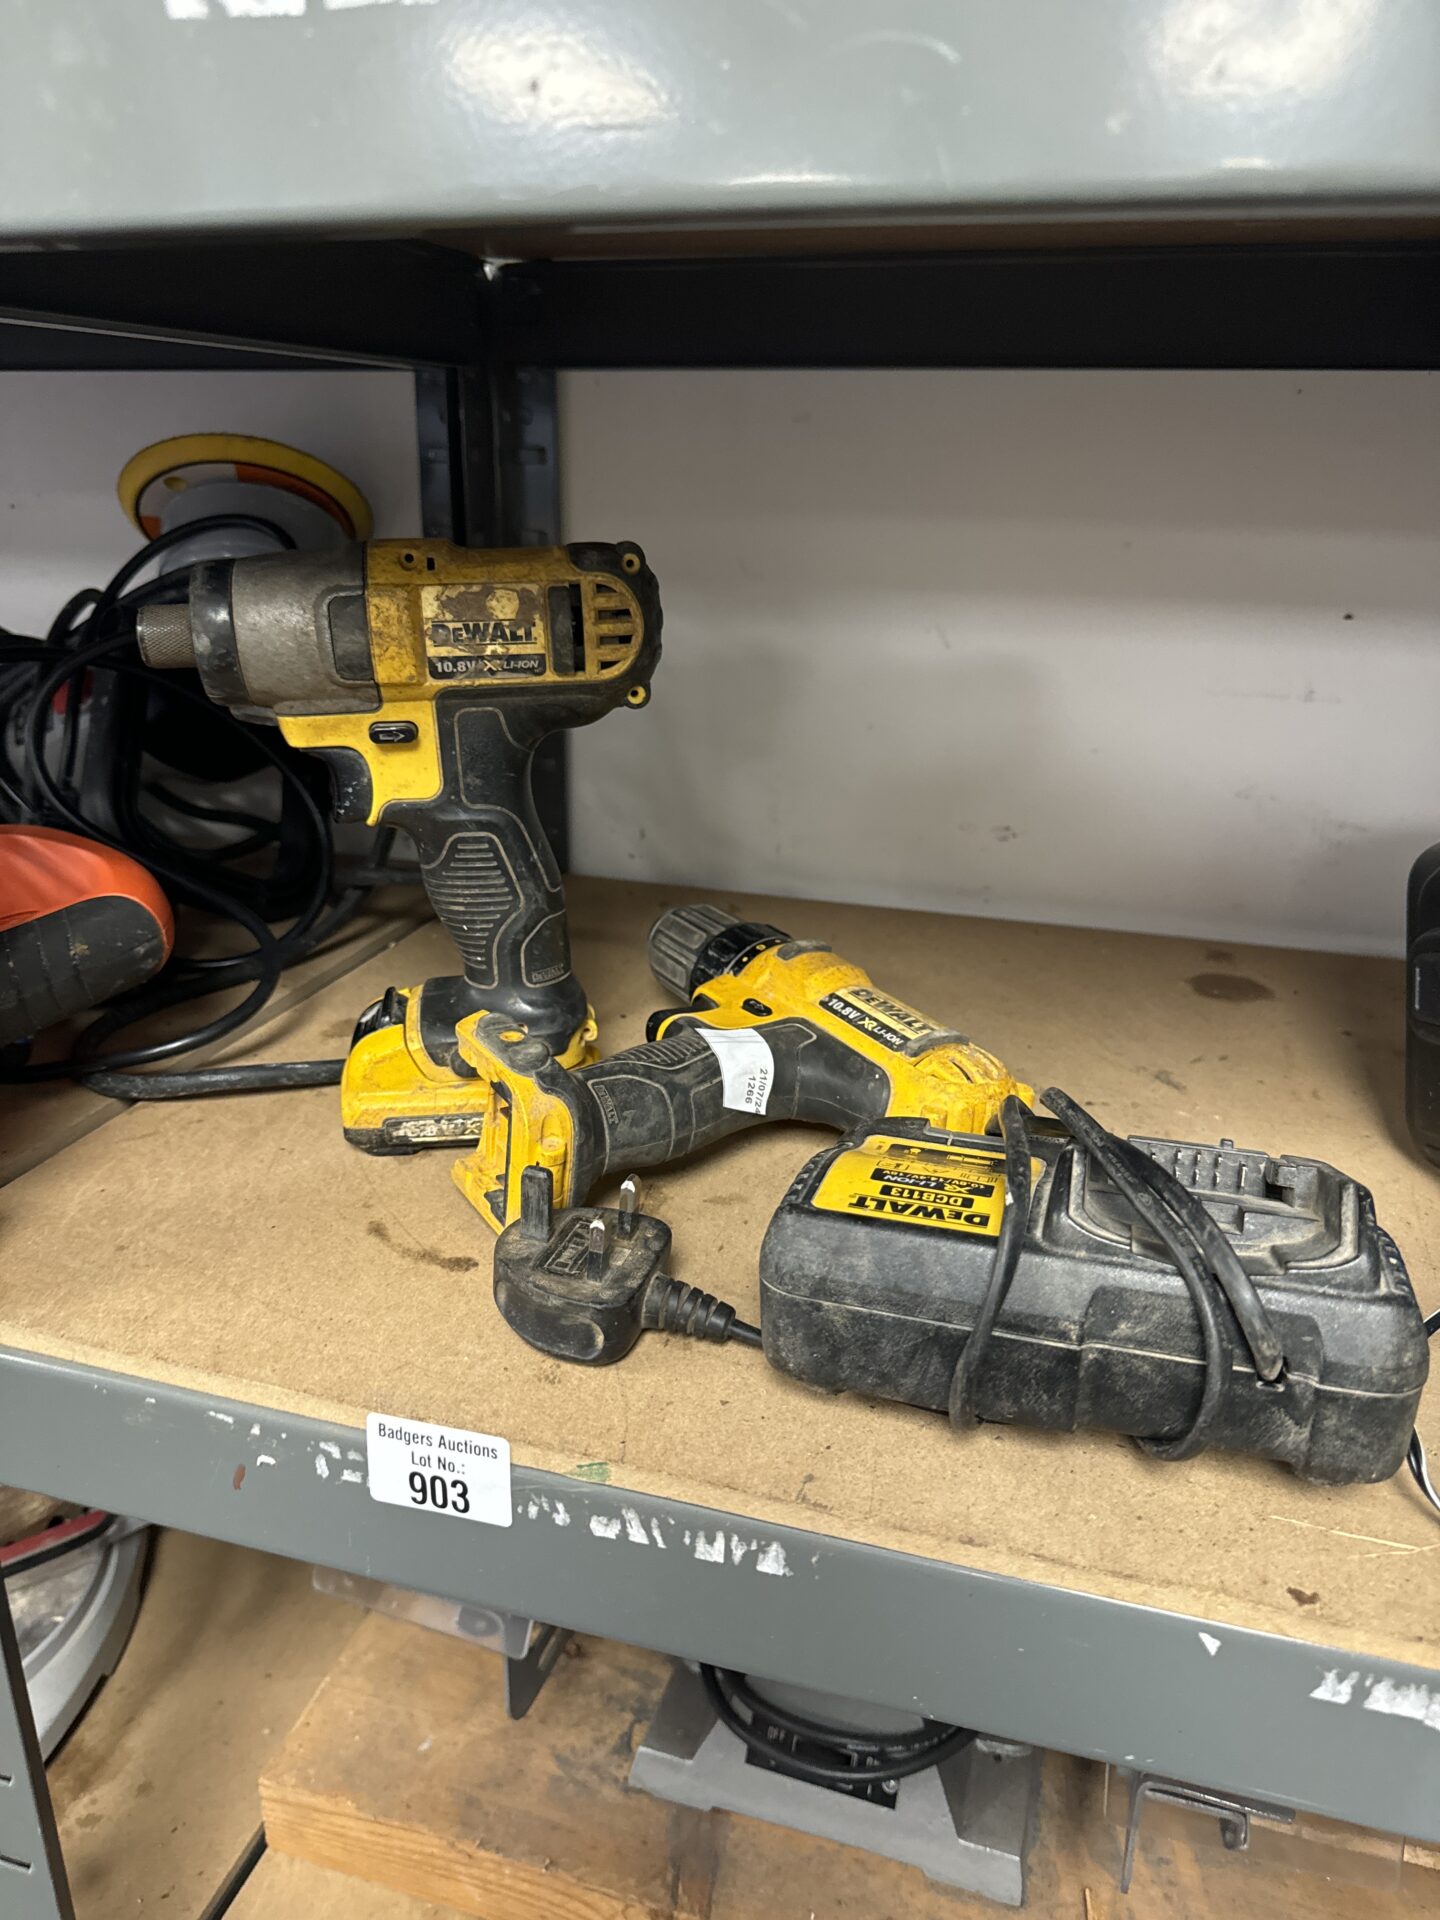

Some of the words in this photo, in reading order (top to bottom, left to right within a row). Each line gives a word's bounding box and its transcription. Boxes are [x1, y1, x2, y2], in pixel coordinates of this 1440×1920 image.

[436, 661, 477, 673] 10.8V
[503, 660, 540, 669] LI-ION
[827, 998, 861, 1020] 10.8V
[873, 1026, 905, 1046] LI-ION
[745, 1075, 757, 1104] 1266
[754, 1068, 769, 1115] 21/07/24
[883, 1175, 937, 1187] LI-ION
[848, 1195, 991, 1228] DEWALT
[890, 1187, 964, 1207] DCB113
[378, 1423, 433, 1446] Badgers
[438, 1434, 498, 1459] Auctions
[411, 1451, 432, 1468] Lot
[437, 1456, 465, 1475] No.:
[408, 1471, 470, 1514] 903
